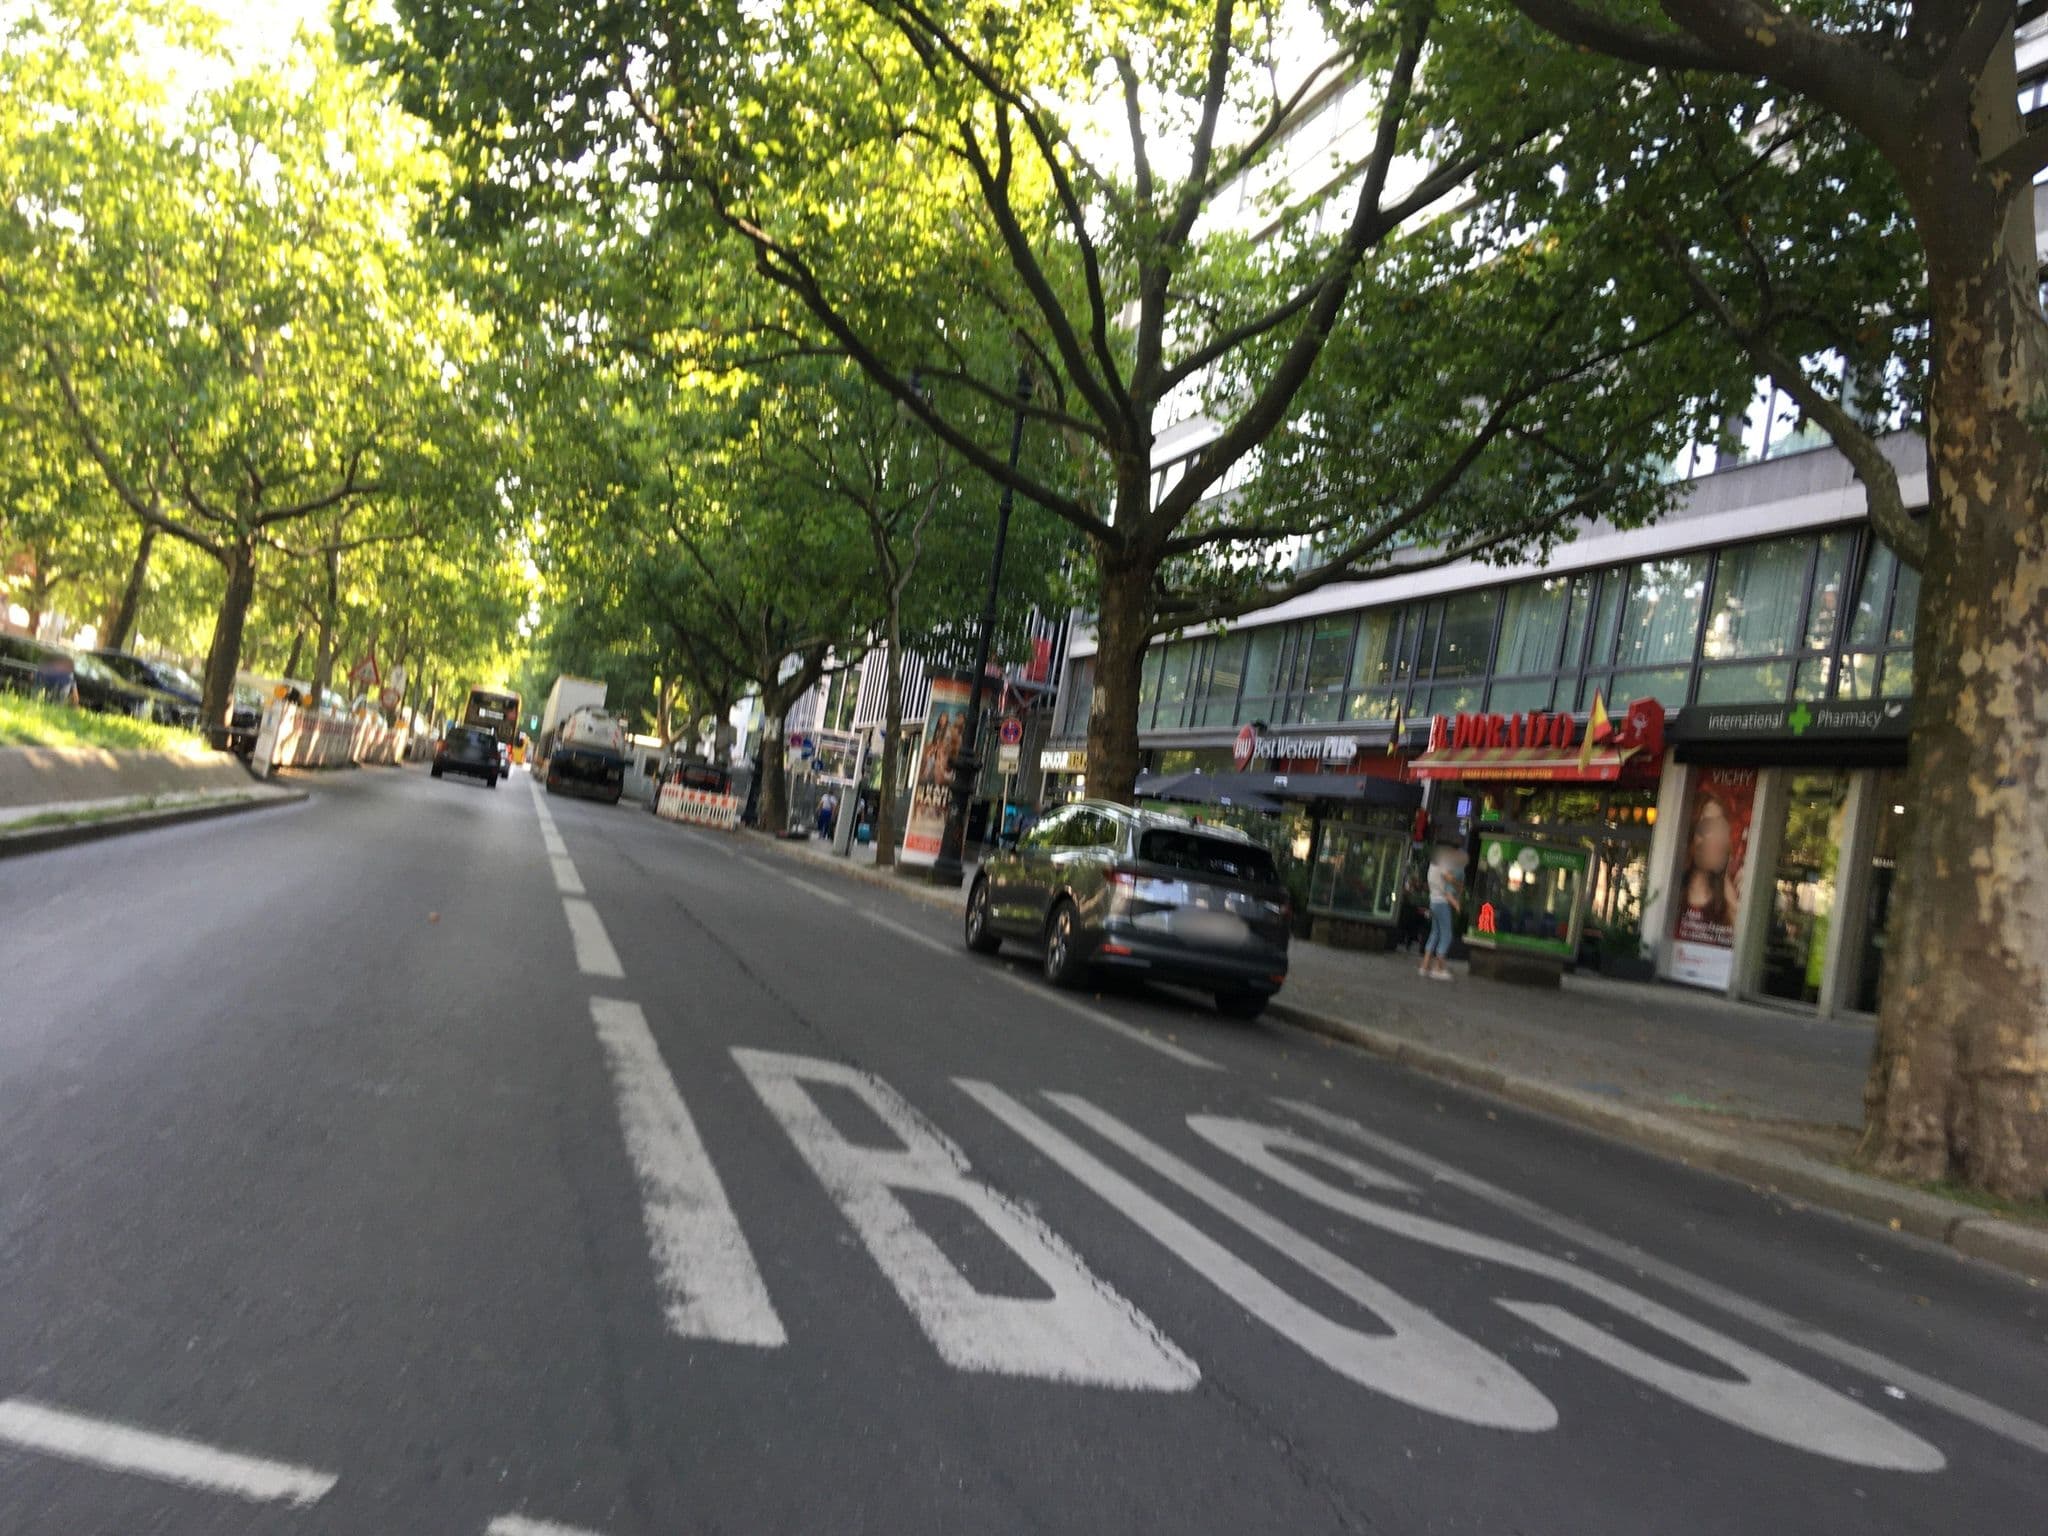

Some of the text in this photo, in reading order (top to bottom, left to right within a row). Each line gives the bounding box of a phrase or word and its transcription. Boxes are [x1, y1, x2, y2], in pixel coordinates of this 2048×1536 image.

[1817, 708, 1882, 732] Pharmacy
[1277, 735, 1321, 759] Western
[728, 1045, 1948, 1474] BUS
